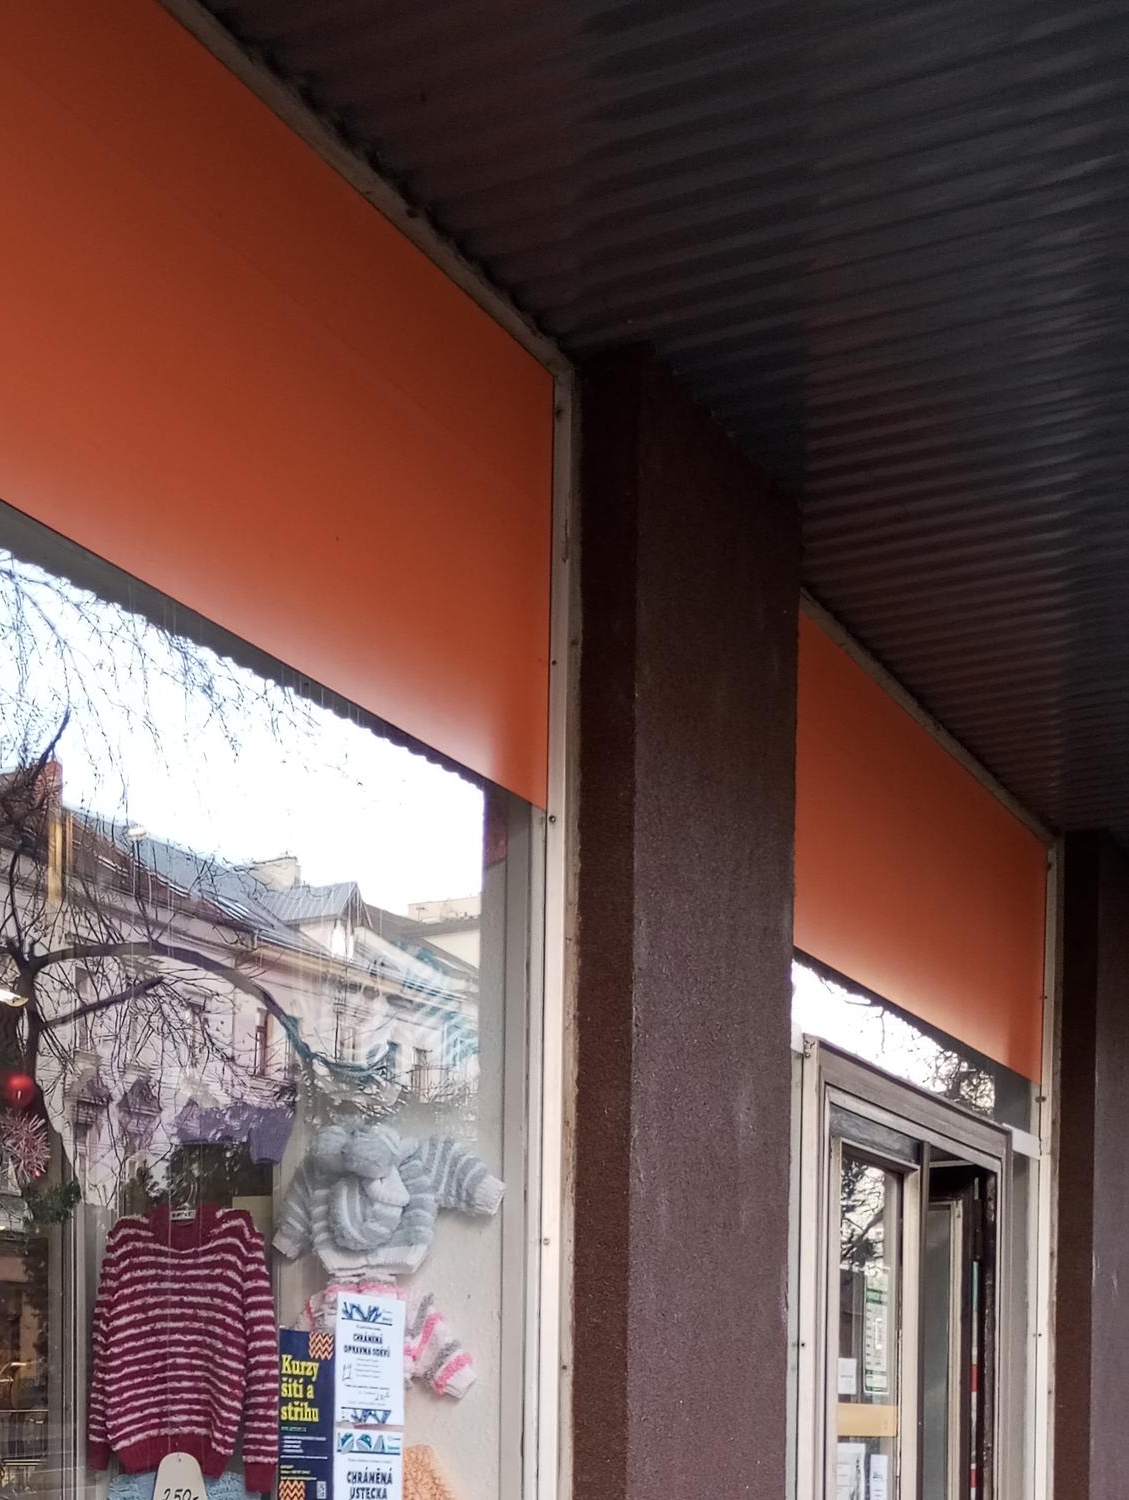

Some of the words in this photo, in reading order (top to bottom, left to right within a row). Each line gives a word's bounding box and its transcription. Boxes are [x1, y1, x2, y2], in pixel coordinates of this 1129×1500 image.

[281, 1353, 319, 1382] Kurzy
[281, 1377, 304, 1399] šití
[306, 1383, 315, 1399] a
[280, 1401, 320, 1422] střihu
